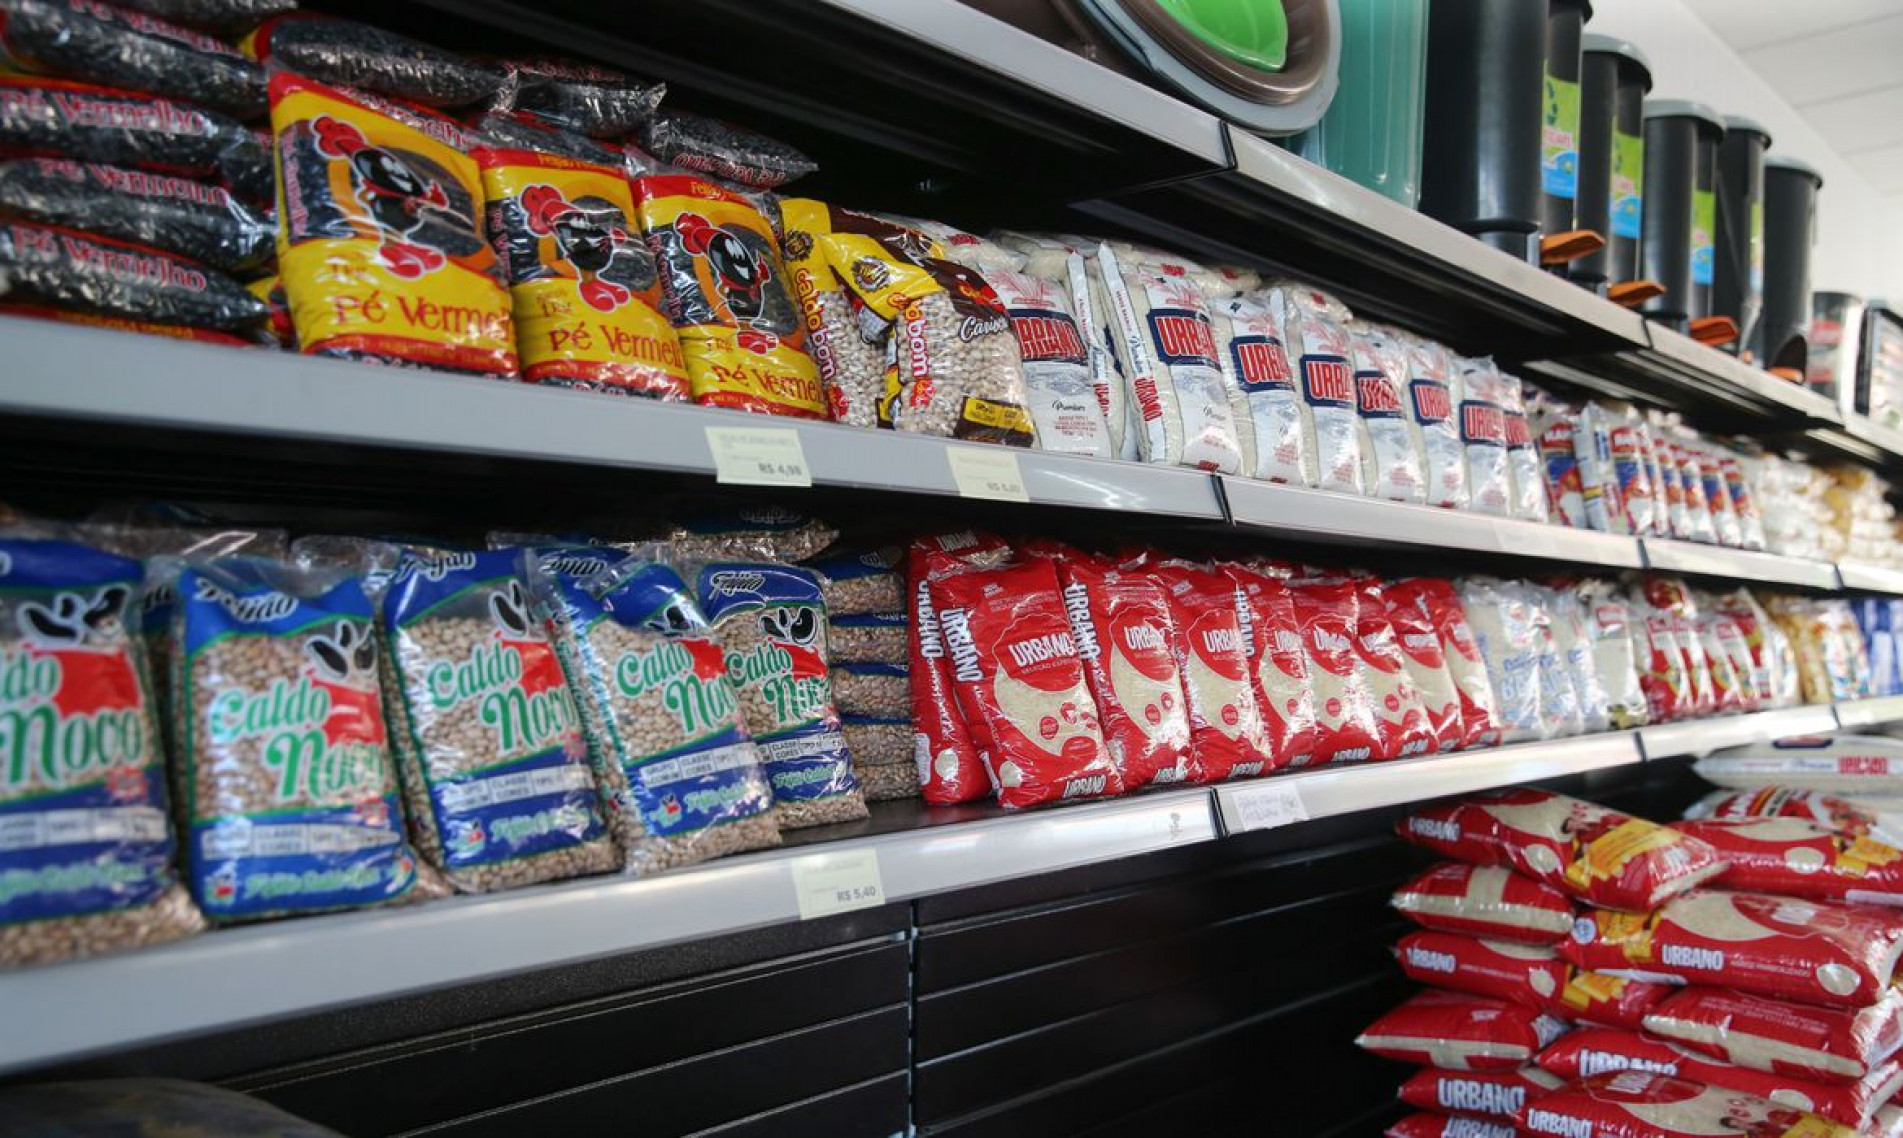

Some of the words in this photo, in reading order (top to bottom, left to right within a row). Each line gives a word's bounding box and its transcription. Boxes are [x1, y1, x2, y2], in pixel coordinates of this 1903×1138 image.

[335, 290, 388, 325] Pé
[549, 321, 593, 352] Pé
[808, 331, 839, 381] bom
[906, 317, 931, 378] bom
[711, 364, 750, 388] Pé
[917, 580, 945, 658] URBANO
[725, 642, 794, 691] Caldo
[940, 608, 984, 683] URBANO
[1008, 631, 1076, 668] URBANO
[427, 640, 521, 710] Caldo
[613, 644, 693, 698] Caldo
[208, 681, 333, 745] Caldo
[1405, 947, 1457, 973] URBANO
[1662, 943, 1724, 971] URBANO
[1438, 1077, 1526, 1115] URBANO
[1528, 1107, 1593, 1138] URBANO
